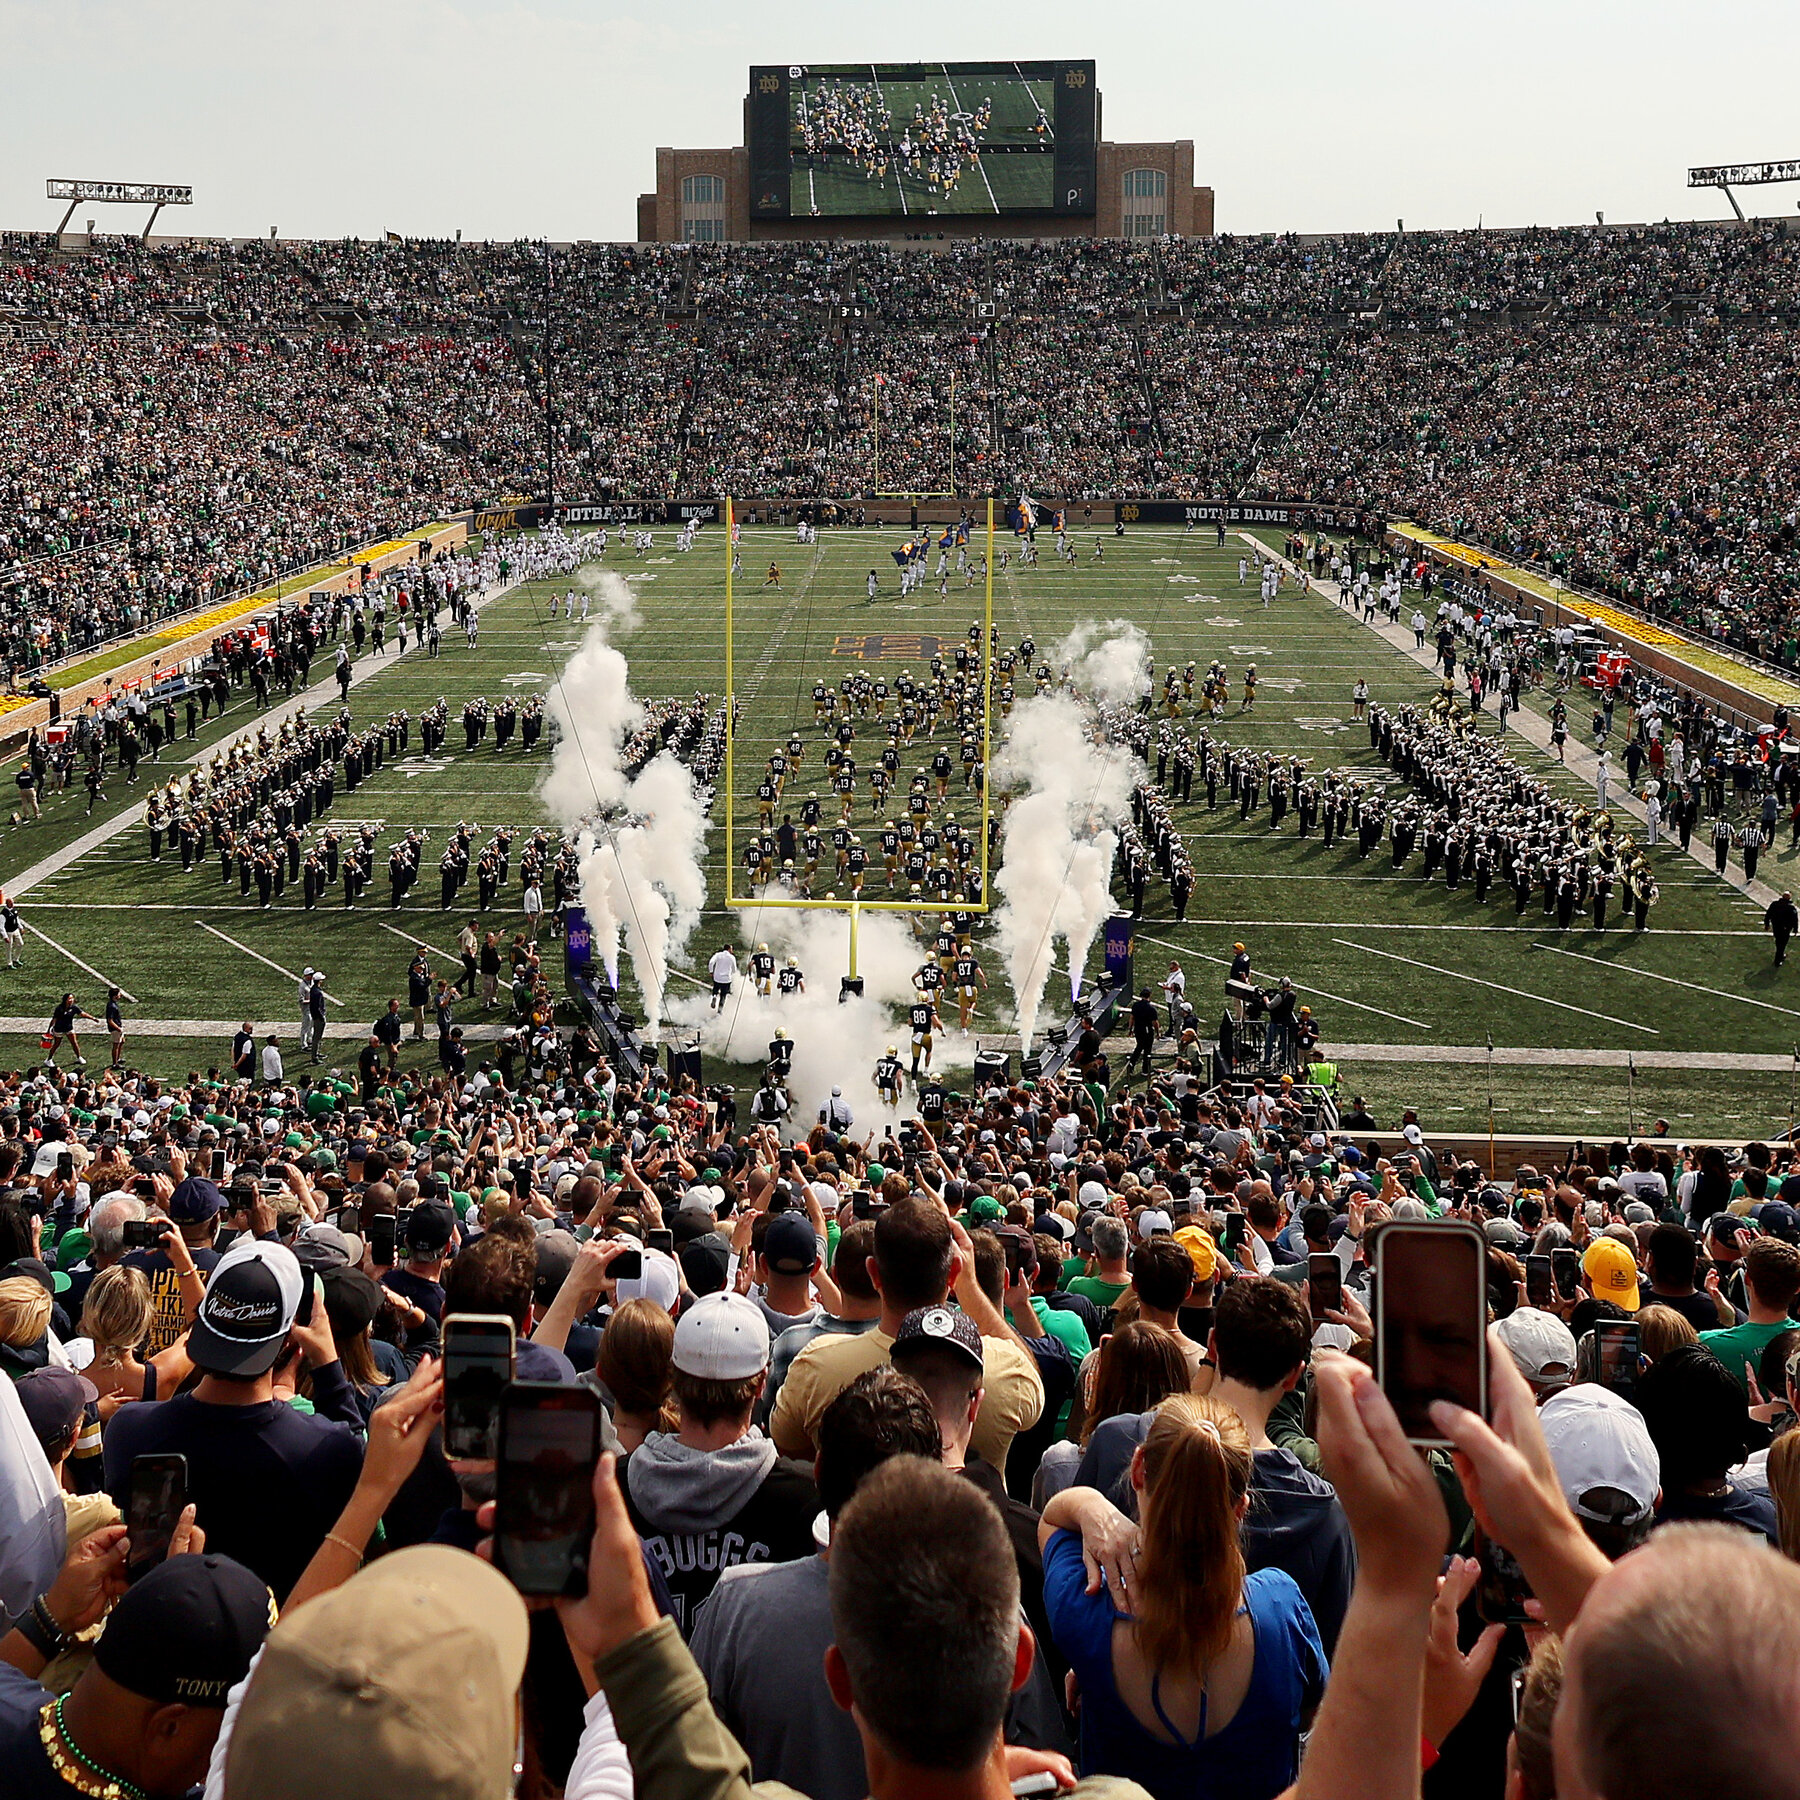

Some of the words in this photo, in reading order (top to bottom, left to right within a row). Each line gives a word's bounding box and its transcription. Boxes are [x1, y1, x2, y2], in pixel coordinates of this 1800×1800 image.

[1244, 509, 1288, 522] DAME
[936, 758, 944, 767] 17
[840, 778, 849, 788] 13
[872, 774, 882, 783] 39
[760, 786, 770, 796] 93
[912, 799, 922, 808] 58
[808, 804, 814, 814] 2
[901, 826, 912, 836] 98
[946, 826, 958, 836] 85
[834, 834, 843, 844] 21
[884, 835, 894, 846] 16
[924, 836, 934, 846] 90
[765, 842, 771, 852] 0
[807, 839, 817, 850] 14
[963, 843, 969, 853] 6
[749, 852, 759, 862] 10
[851, 850, 862, 860] 25
[912, 858, 922, 868] 28
[940, 874, 946, 884] 8
[938, 939, 949, 951] 91
[760, 957, 771, 969] 19
[958, 963, 972, 976] 87
[782, 973, 796, 987] 38
[924, 968, 938, 982] 35
[913, 1010, 927, 1024] 88
[781, 1046, 787, 1058] 1
[880, 1062, 896, 1079] 37
[924, 1093, 941, 1108] 20
[208, 1296, 235, 1319] Notre
[232, 1304, 278, 1321] Dame
[176, 1677, 226, 1697] TONY
